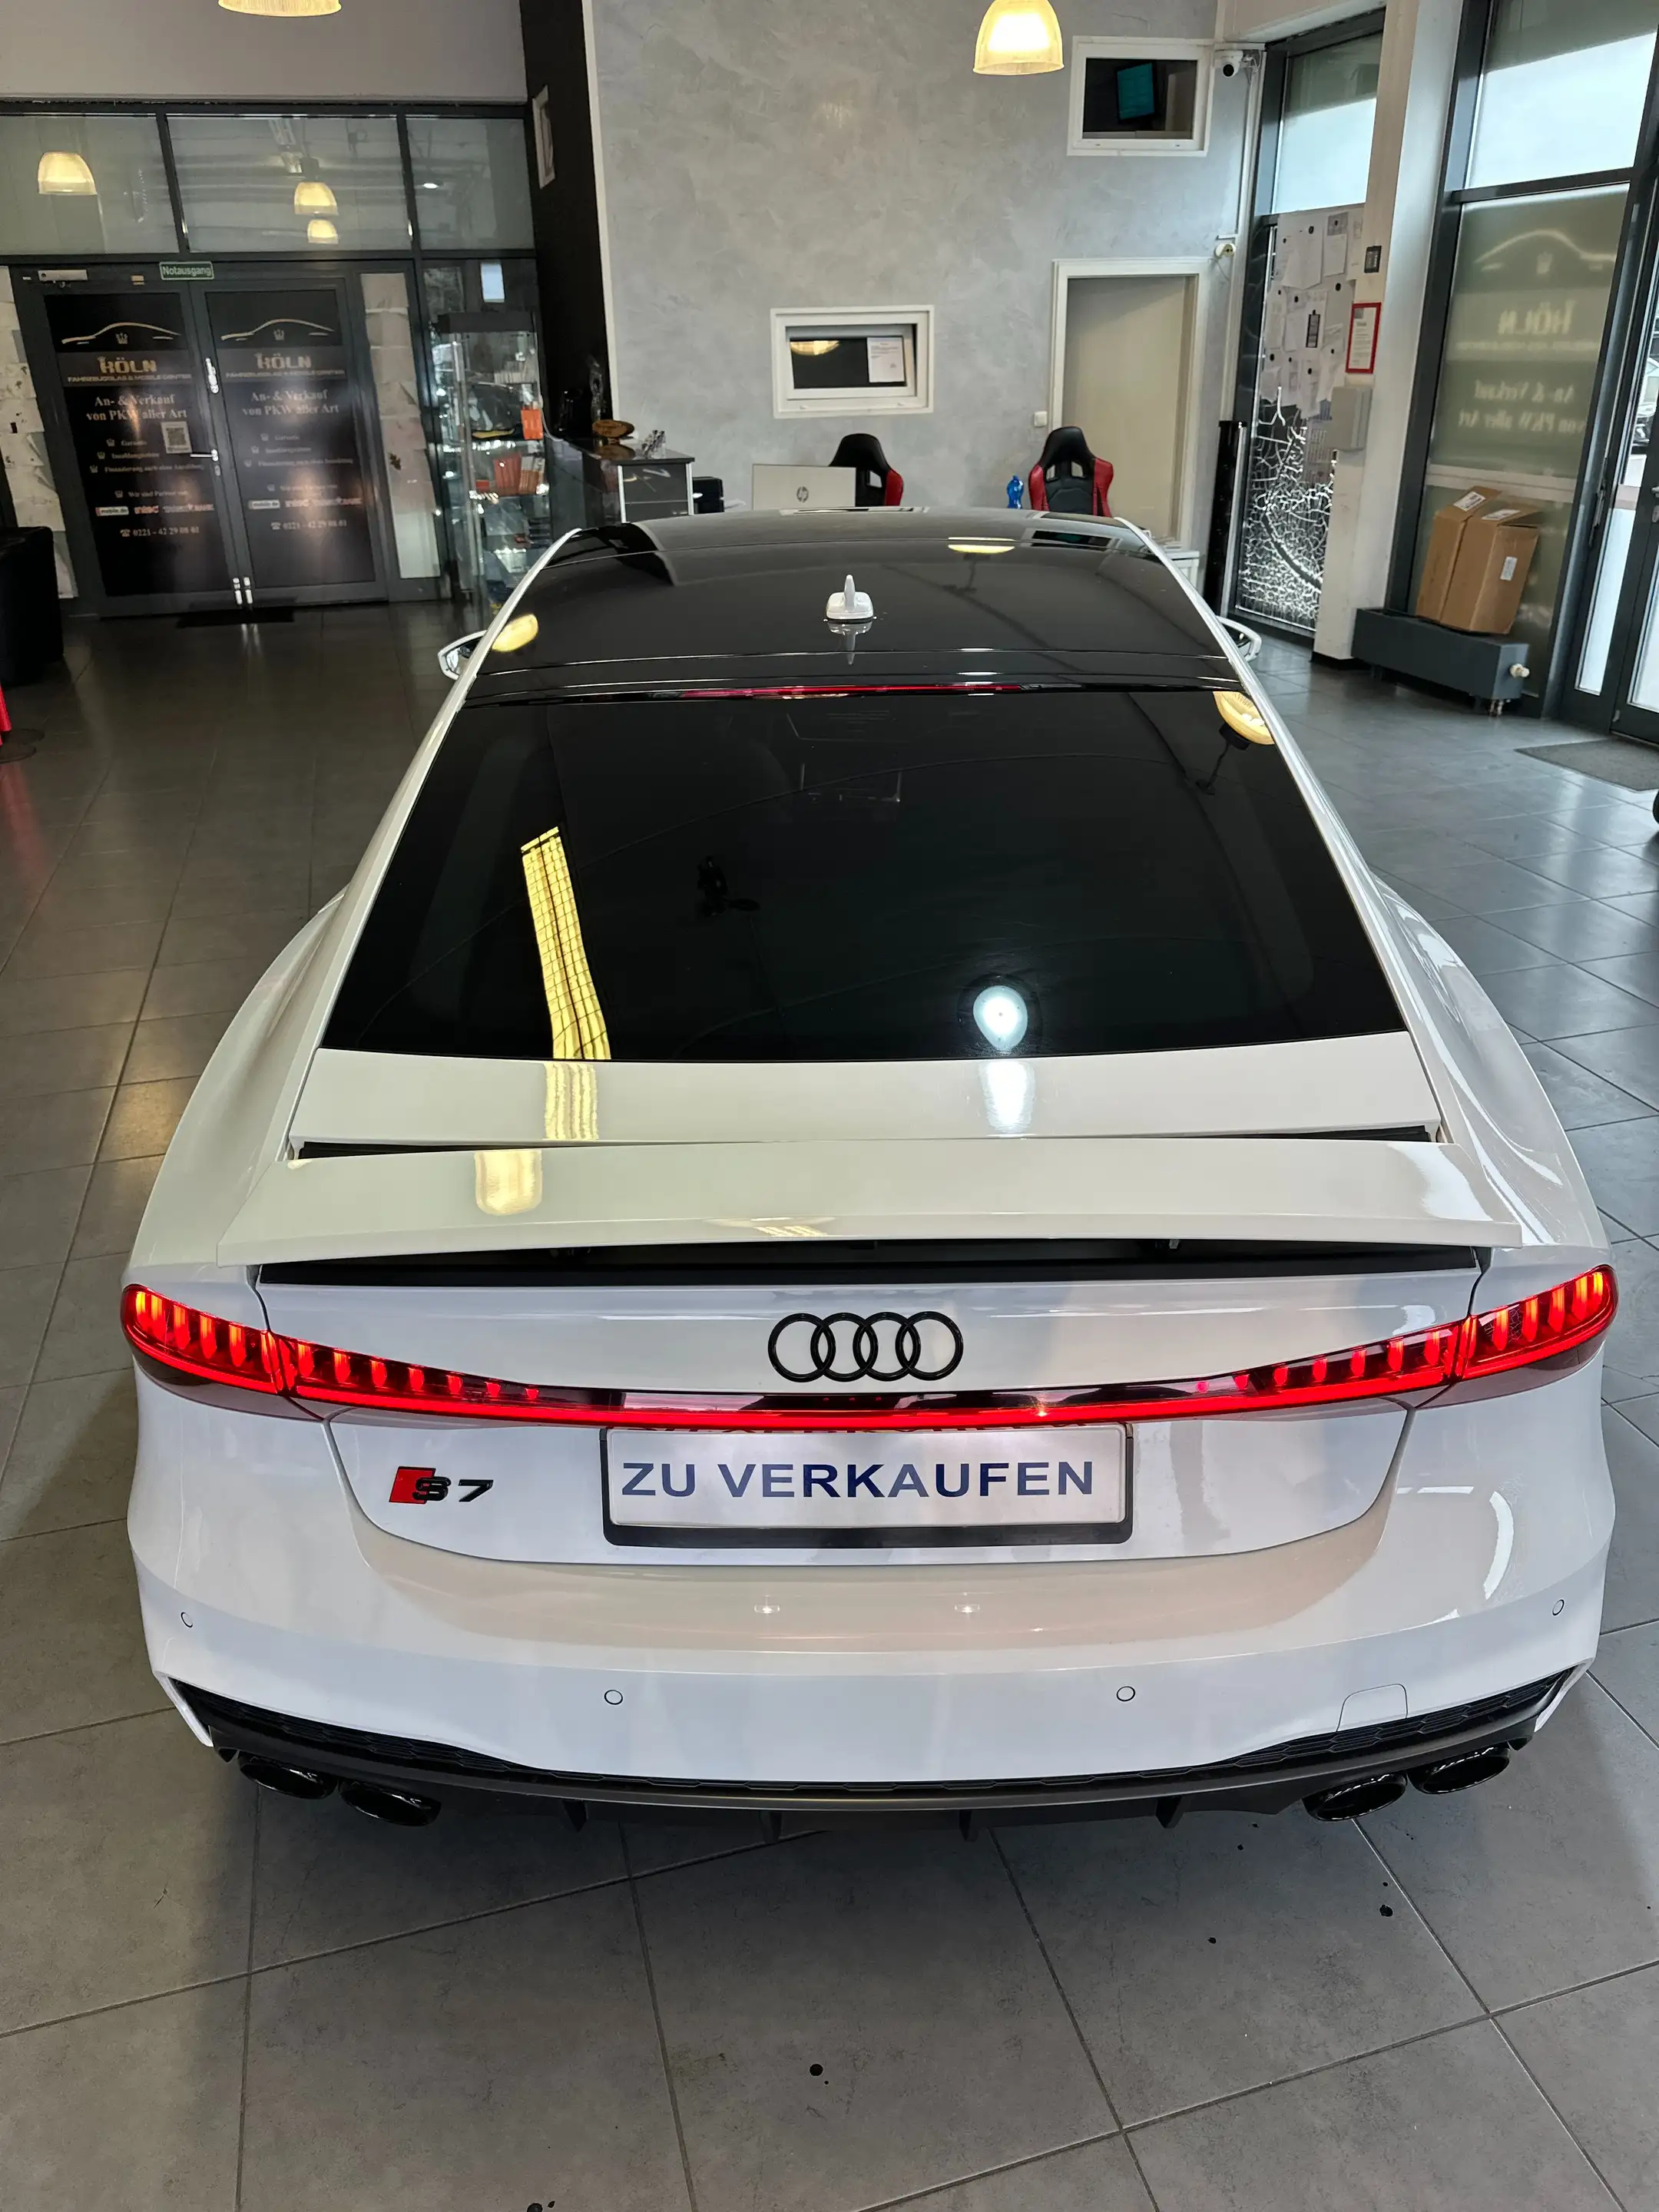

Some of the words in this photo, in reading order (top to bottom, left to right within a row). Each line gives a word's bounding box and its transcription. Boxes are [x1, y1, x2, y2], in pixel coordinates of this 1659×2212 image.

[162, 266, 212, 276] Notausgang
[98, 356, 157, 373] KÖLN
[254, 353, 312, 369] KÖLN
[94, 396, 115, 406] An-
[118, 396, 127, 406] &
[251, 392, 270, 402] An-
[273, 392, 283, 400] &
[86, 412, 107, 421] von
[169, 409, 187, 418] Art
[264, 406, 292, 415] PKW
[321, 404, 339, 413] Art
[621, 1462, 697, 1498] ZU
[717, 1461, 1093, 1498] VERKAUFEN
[412, 1475, 494, 1502] S7
